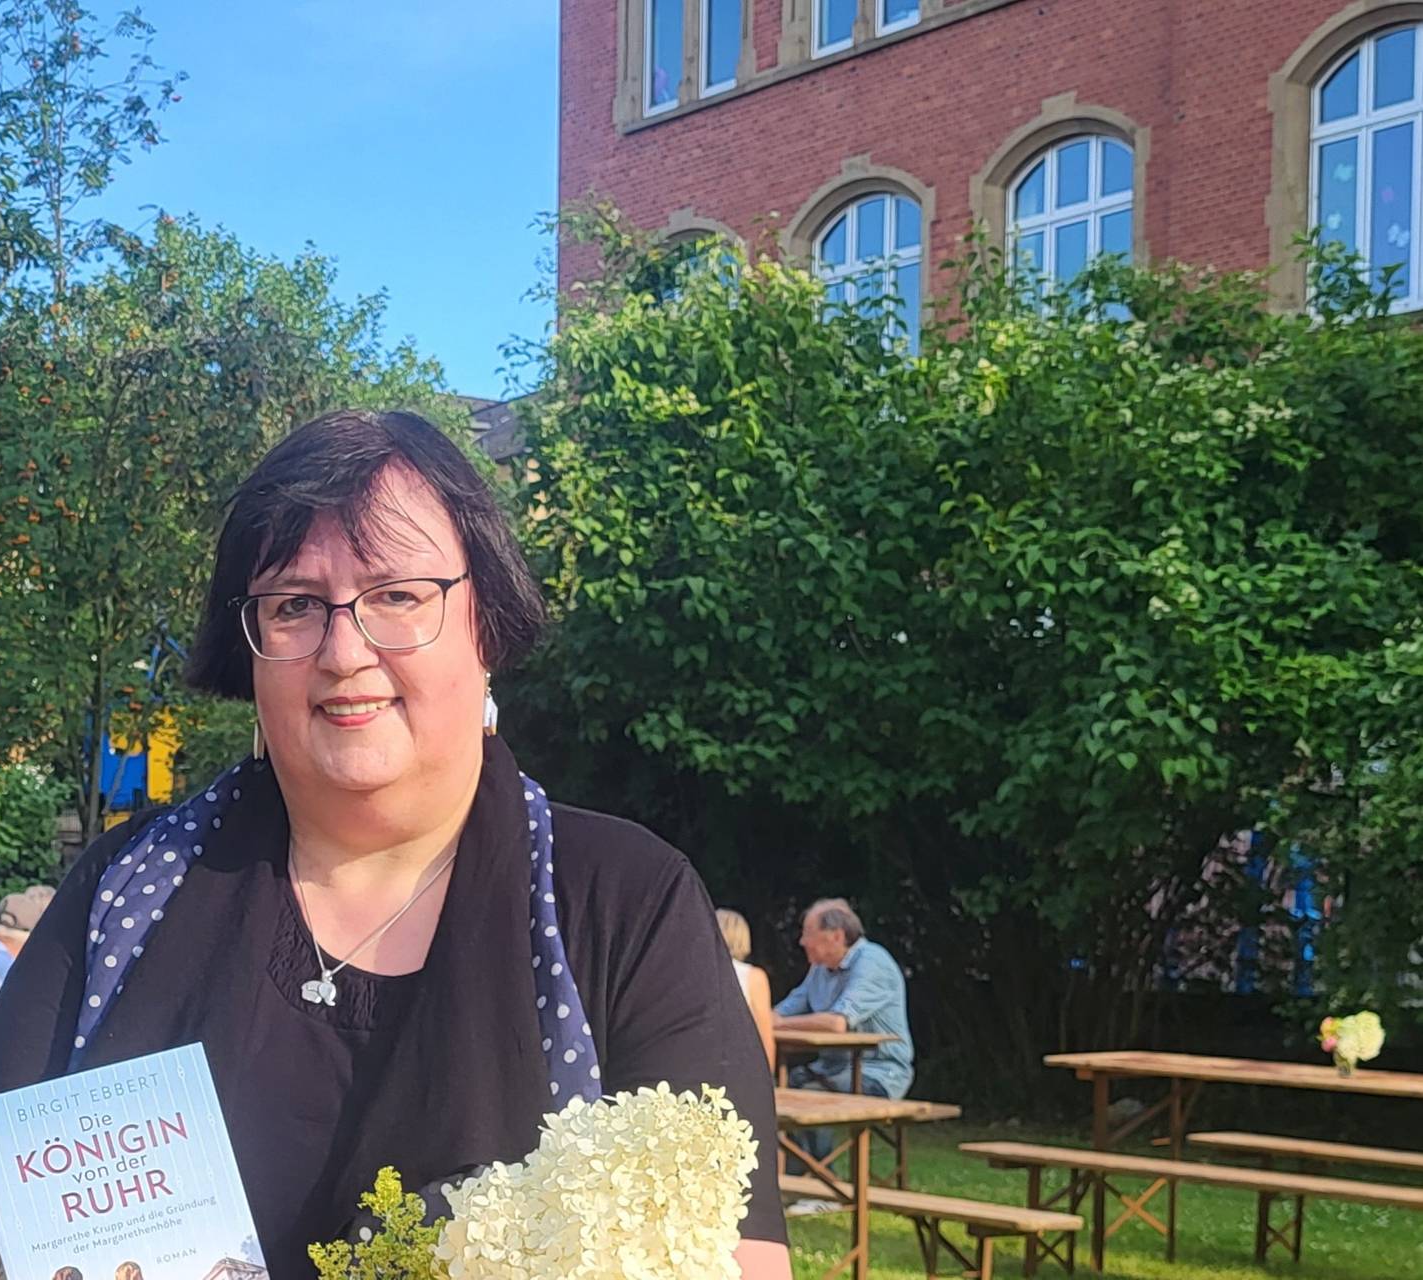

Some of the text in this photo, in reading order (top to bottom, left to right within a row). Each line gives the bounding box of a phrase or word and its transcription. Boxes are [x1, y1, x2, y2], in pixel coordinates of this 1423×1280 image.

[17, 1073, 160, 1122] BIRGIT EBBERT
[79, 1112, 113, 1132] Die
[15, 1112, 189, 1184] KÖNIGIN
[72, 1152, 147, 1184] von der
[60, 1168, 174, 1223] RUHR
[31, 1195, 216, 1253] Margarethe Krupp und die Gründung
[73, 1218, 182, 1254] der Margarethenhöhe
[156, 1247, 197, 1264] ROMAN
